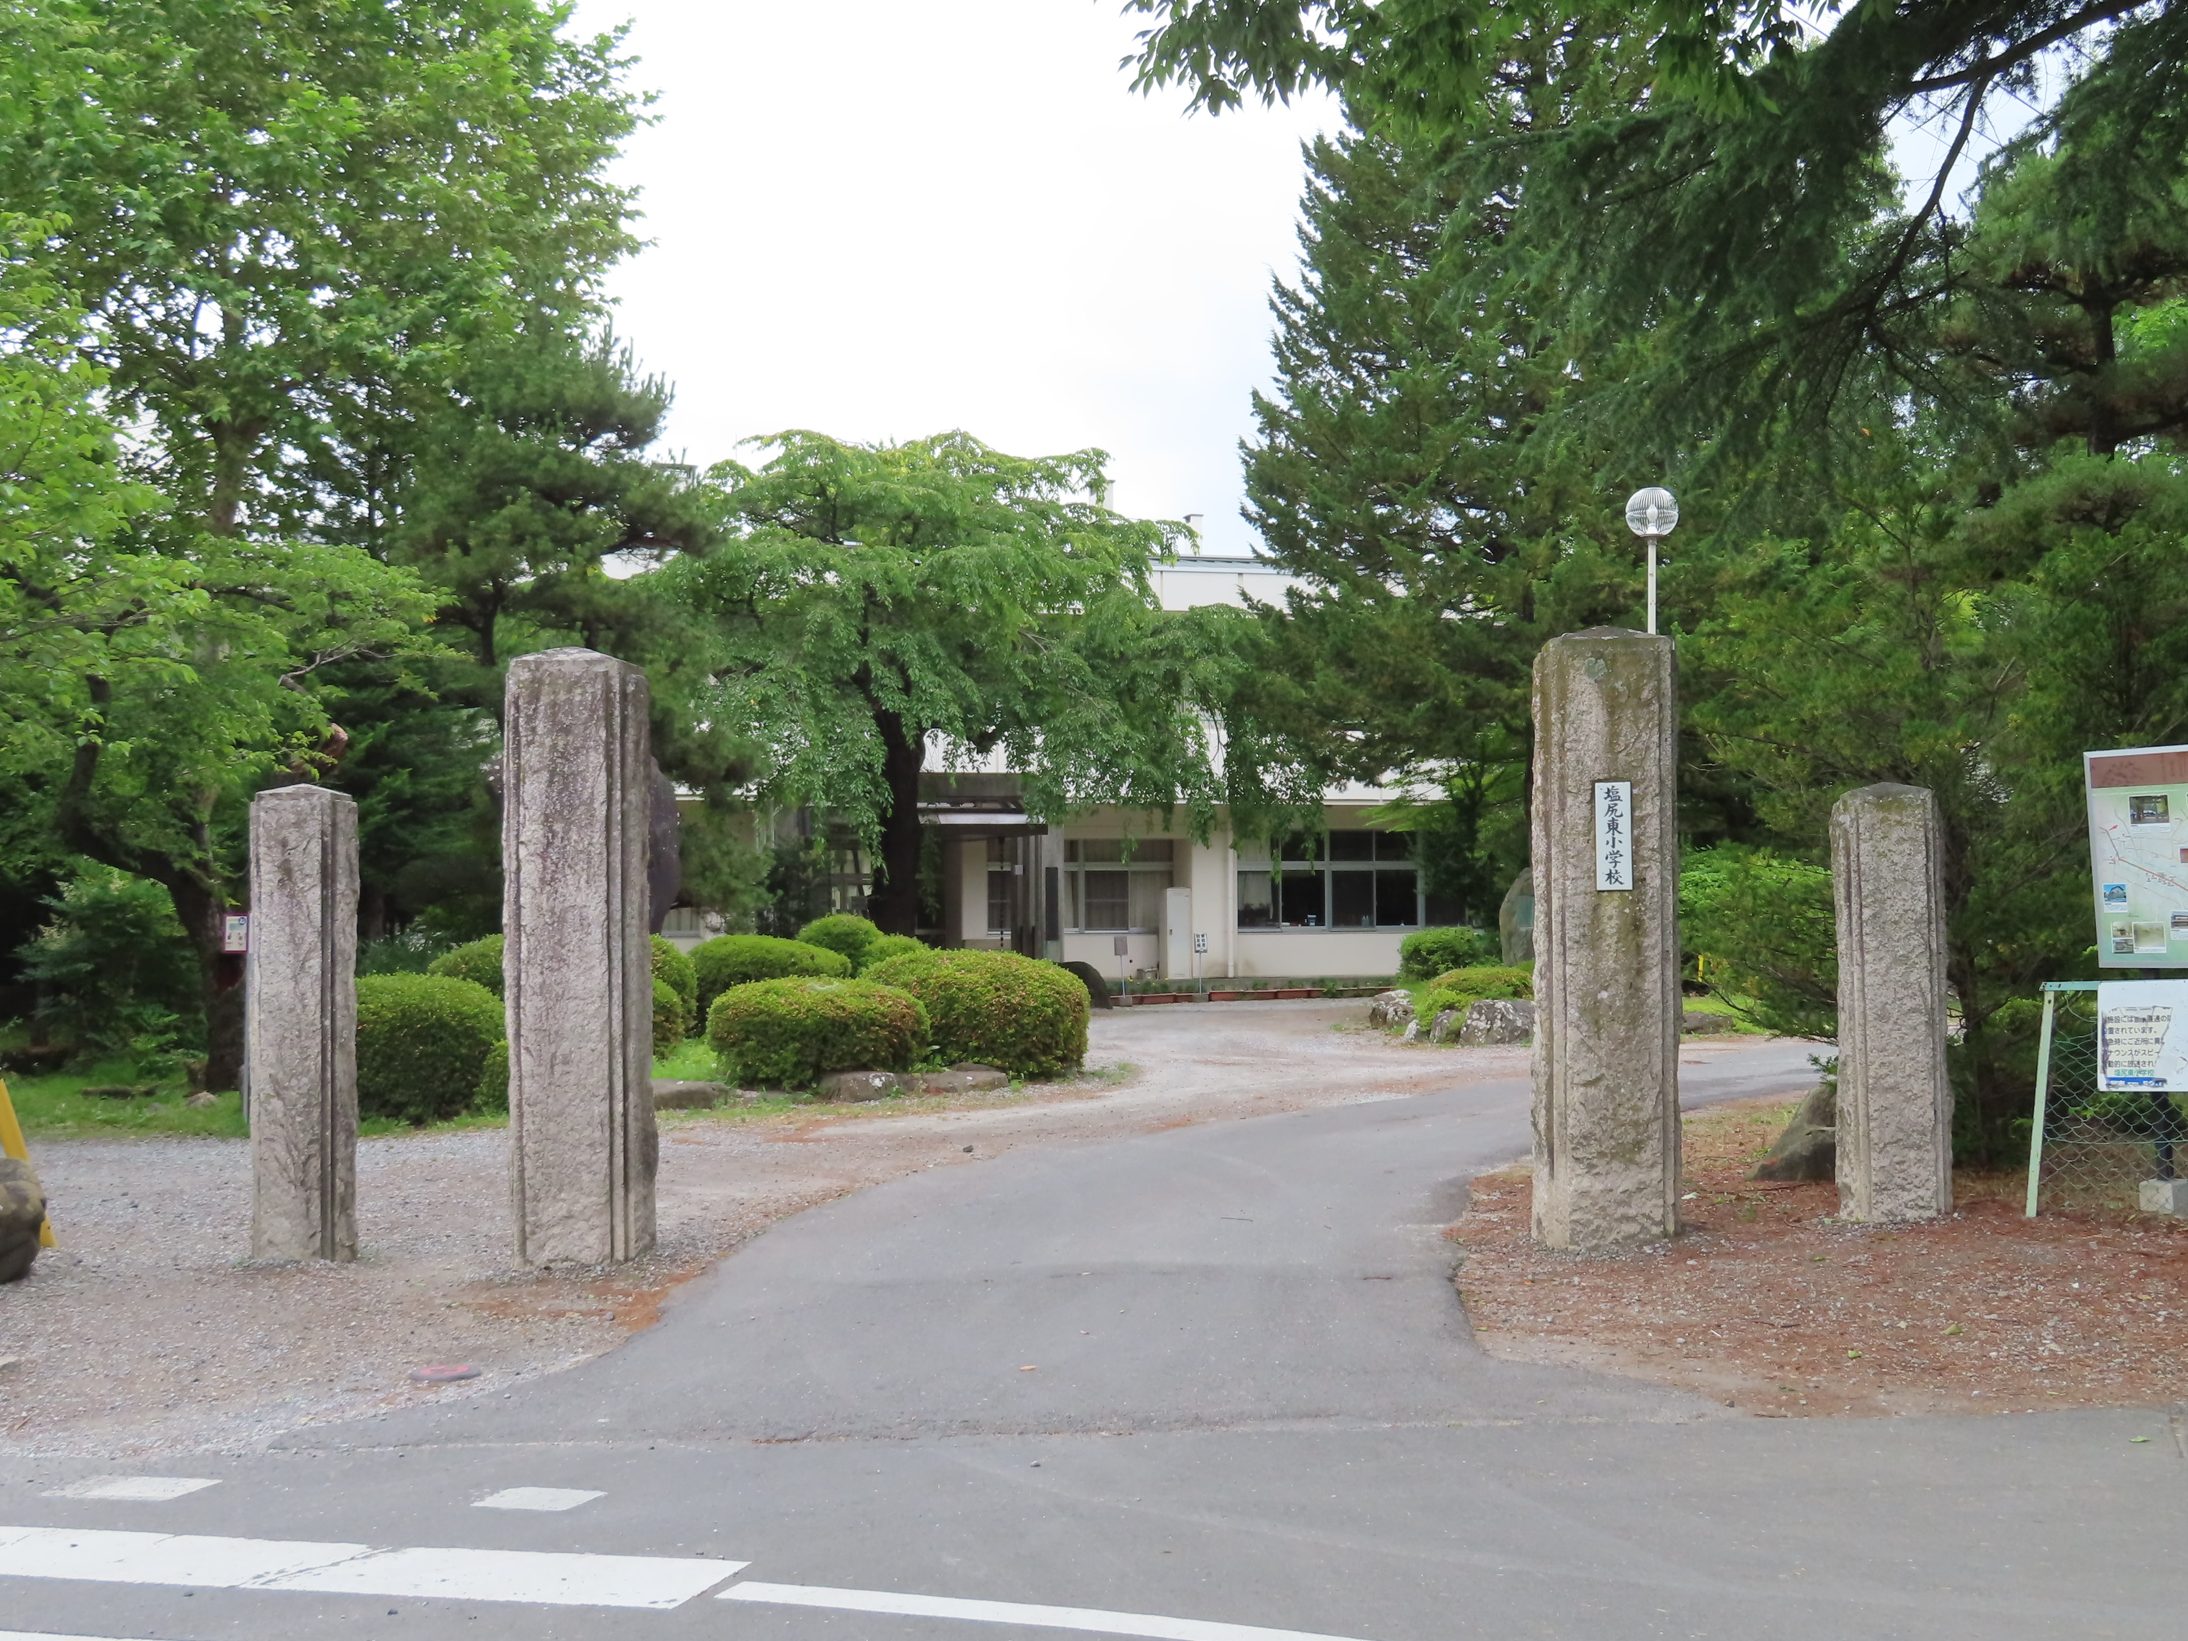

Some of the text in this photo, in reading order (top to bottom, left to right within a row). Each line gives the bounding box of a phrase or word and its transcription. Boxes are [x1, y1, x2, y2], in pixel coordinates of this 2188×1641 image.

[1604, 785, 1624, 885] 塩尻東小学校
